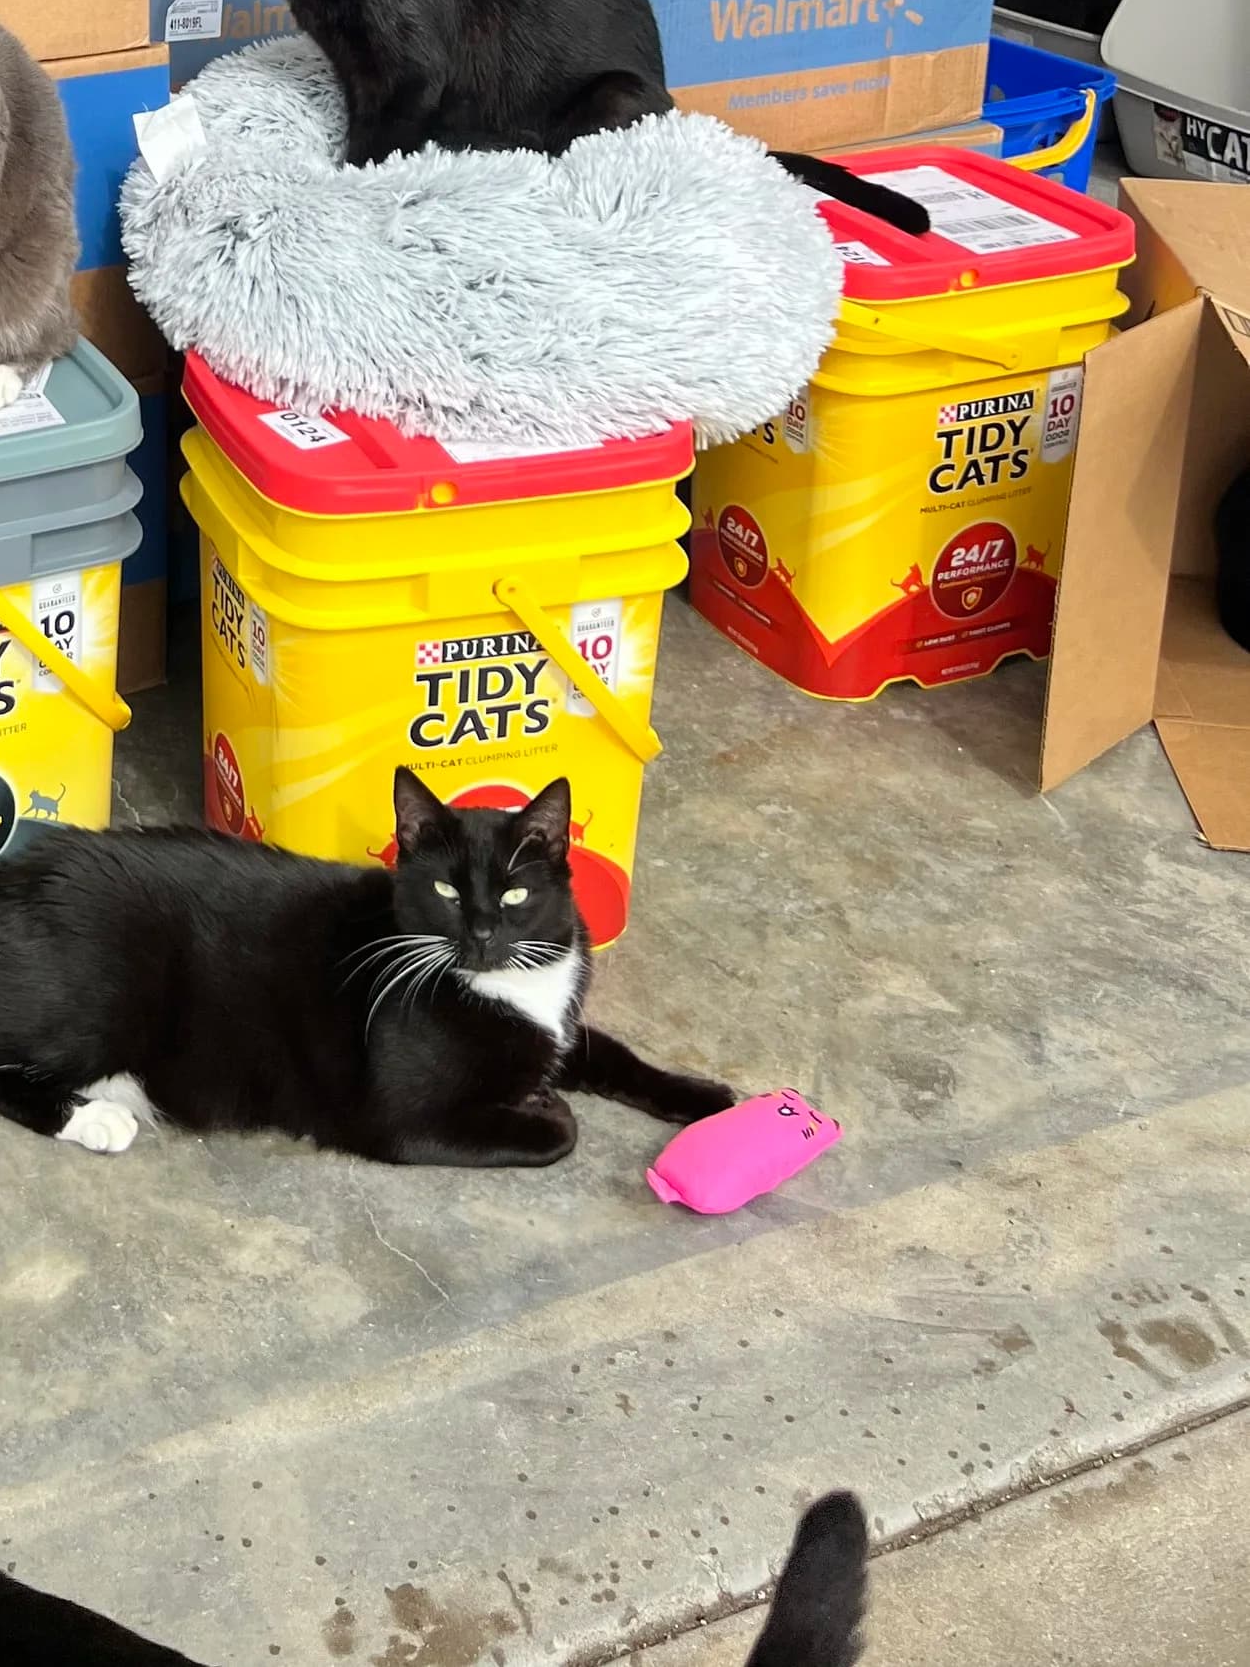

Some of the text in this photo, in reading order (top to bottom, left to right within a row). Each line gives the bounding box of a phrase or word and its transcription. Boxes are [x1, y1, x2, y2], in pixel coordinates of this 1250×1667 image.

[727, 86, 806, 110] Members
[813, 82, 847, 99] save
[958, 392, 1031, 420] PURINA
[1048, 393, 1075, 418] 10
[280, 412, 327, 442] 0124
[937, 416, 1030, 459] TIDY
[1047, 417, 1070, 432] DAY
[929, 448, 1028, 494] CATS
[727, 517, 759, 547] 24/7
[951, 539, 1005, 567] 24/7
[937, 557, 1011, 581] PERFORMANCE
[212, 571, 244, 627] TIDY
[40, 610, 75, 638] 10
[212, 600, 246, 669] CATS
[251, 619, 266, 641] 10
[578, 635, 613, 661] 10
[416, 658, 549, 707] TIDY
[410, 699, 549, 747] CATS
[465, 749, 521, 766] CLUMPING
[523, 744, 559, 757] LITTER
